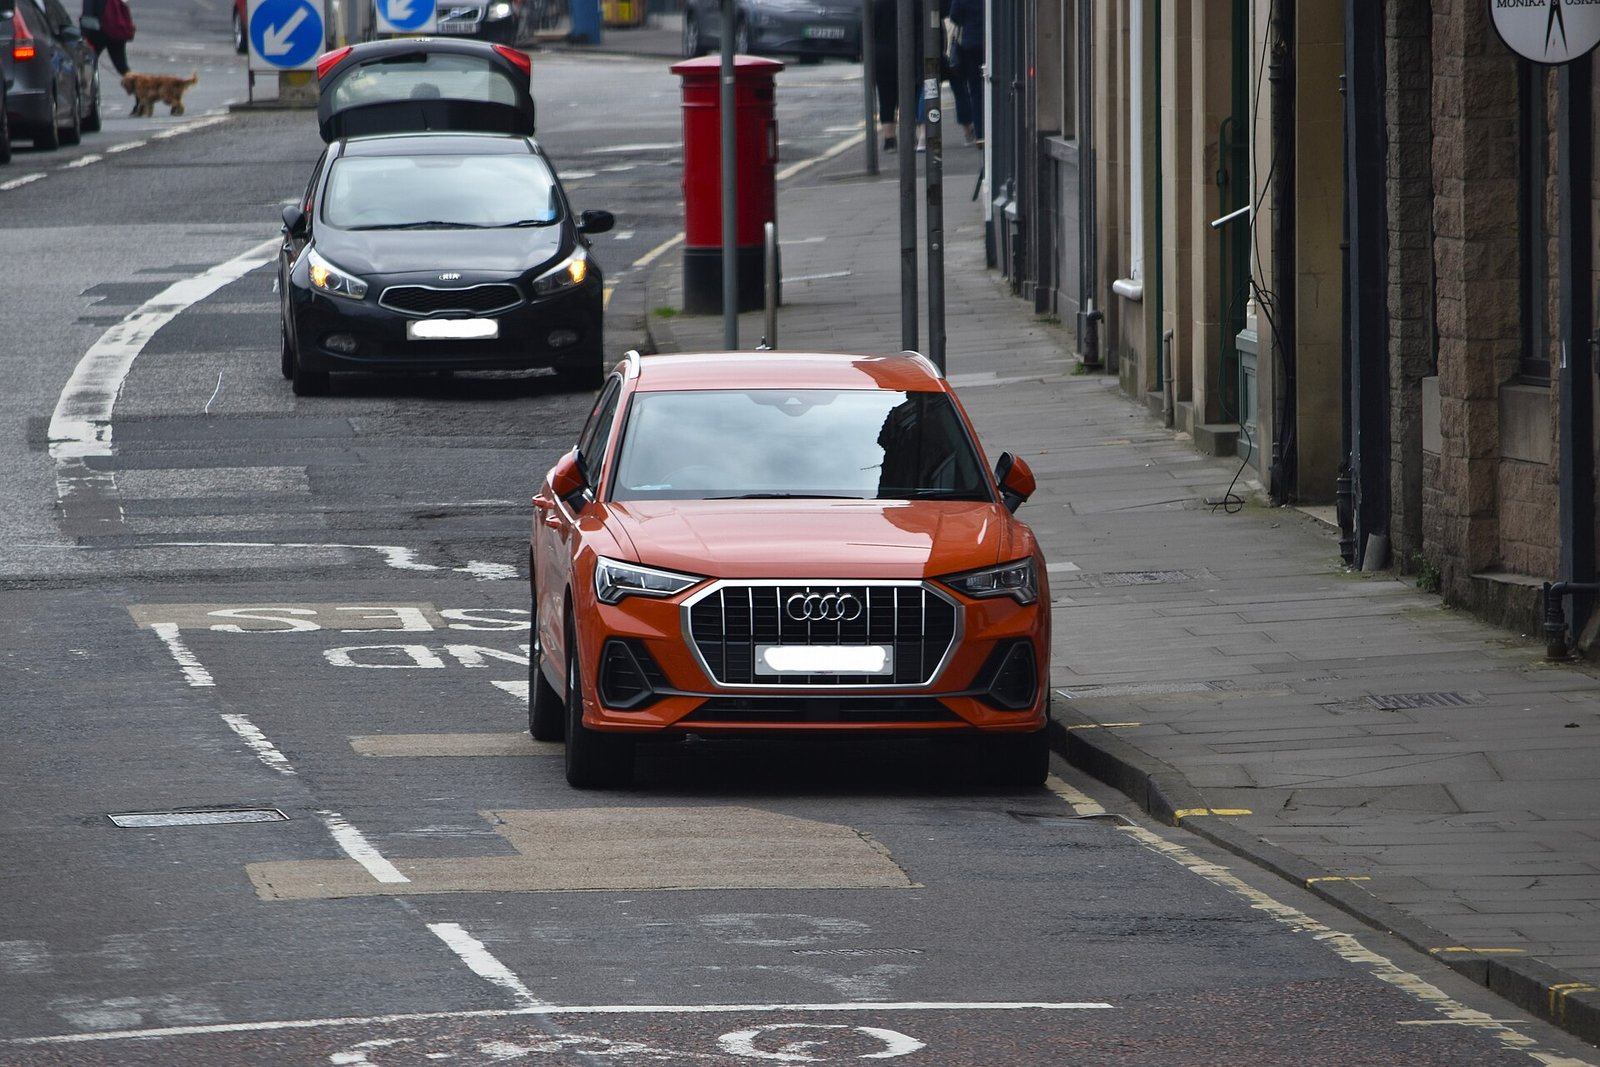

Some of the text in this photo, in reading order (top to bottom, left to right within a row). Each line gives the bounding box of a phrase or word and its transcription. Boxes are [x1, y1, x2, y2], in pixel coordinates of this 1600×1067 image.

[1497, 0, 1546, 8] MONIKA
[208, 607, 531, 633] SES
[322, 644, 530, 669] ND
